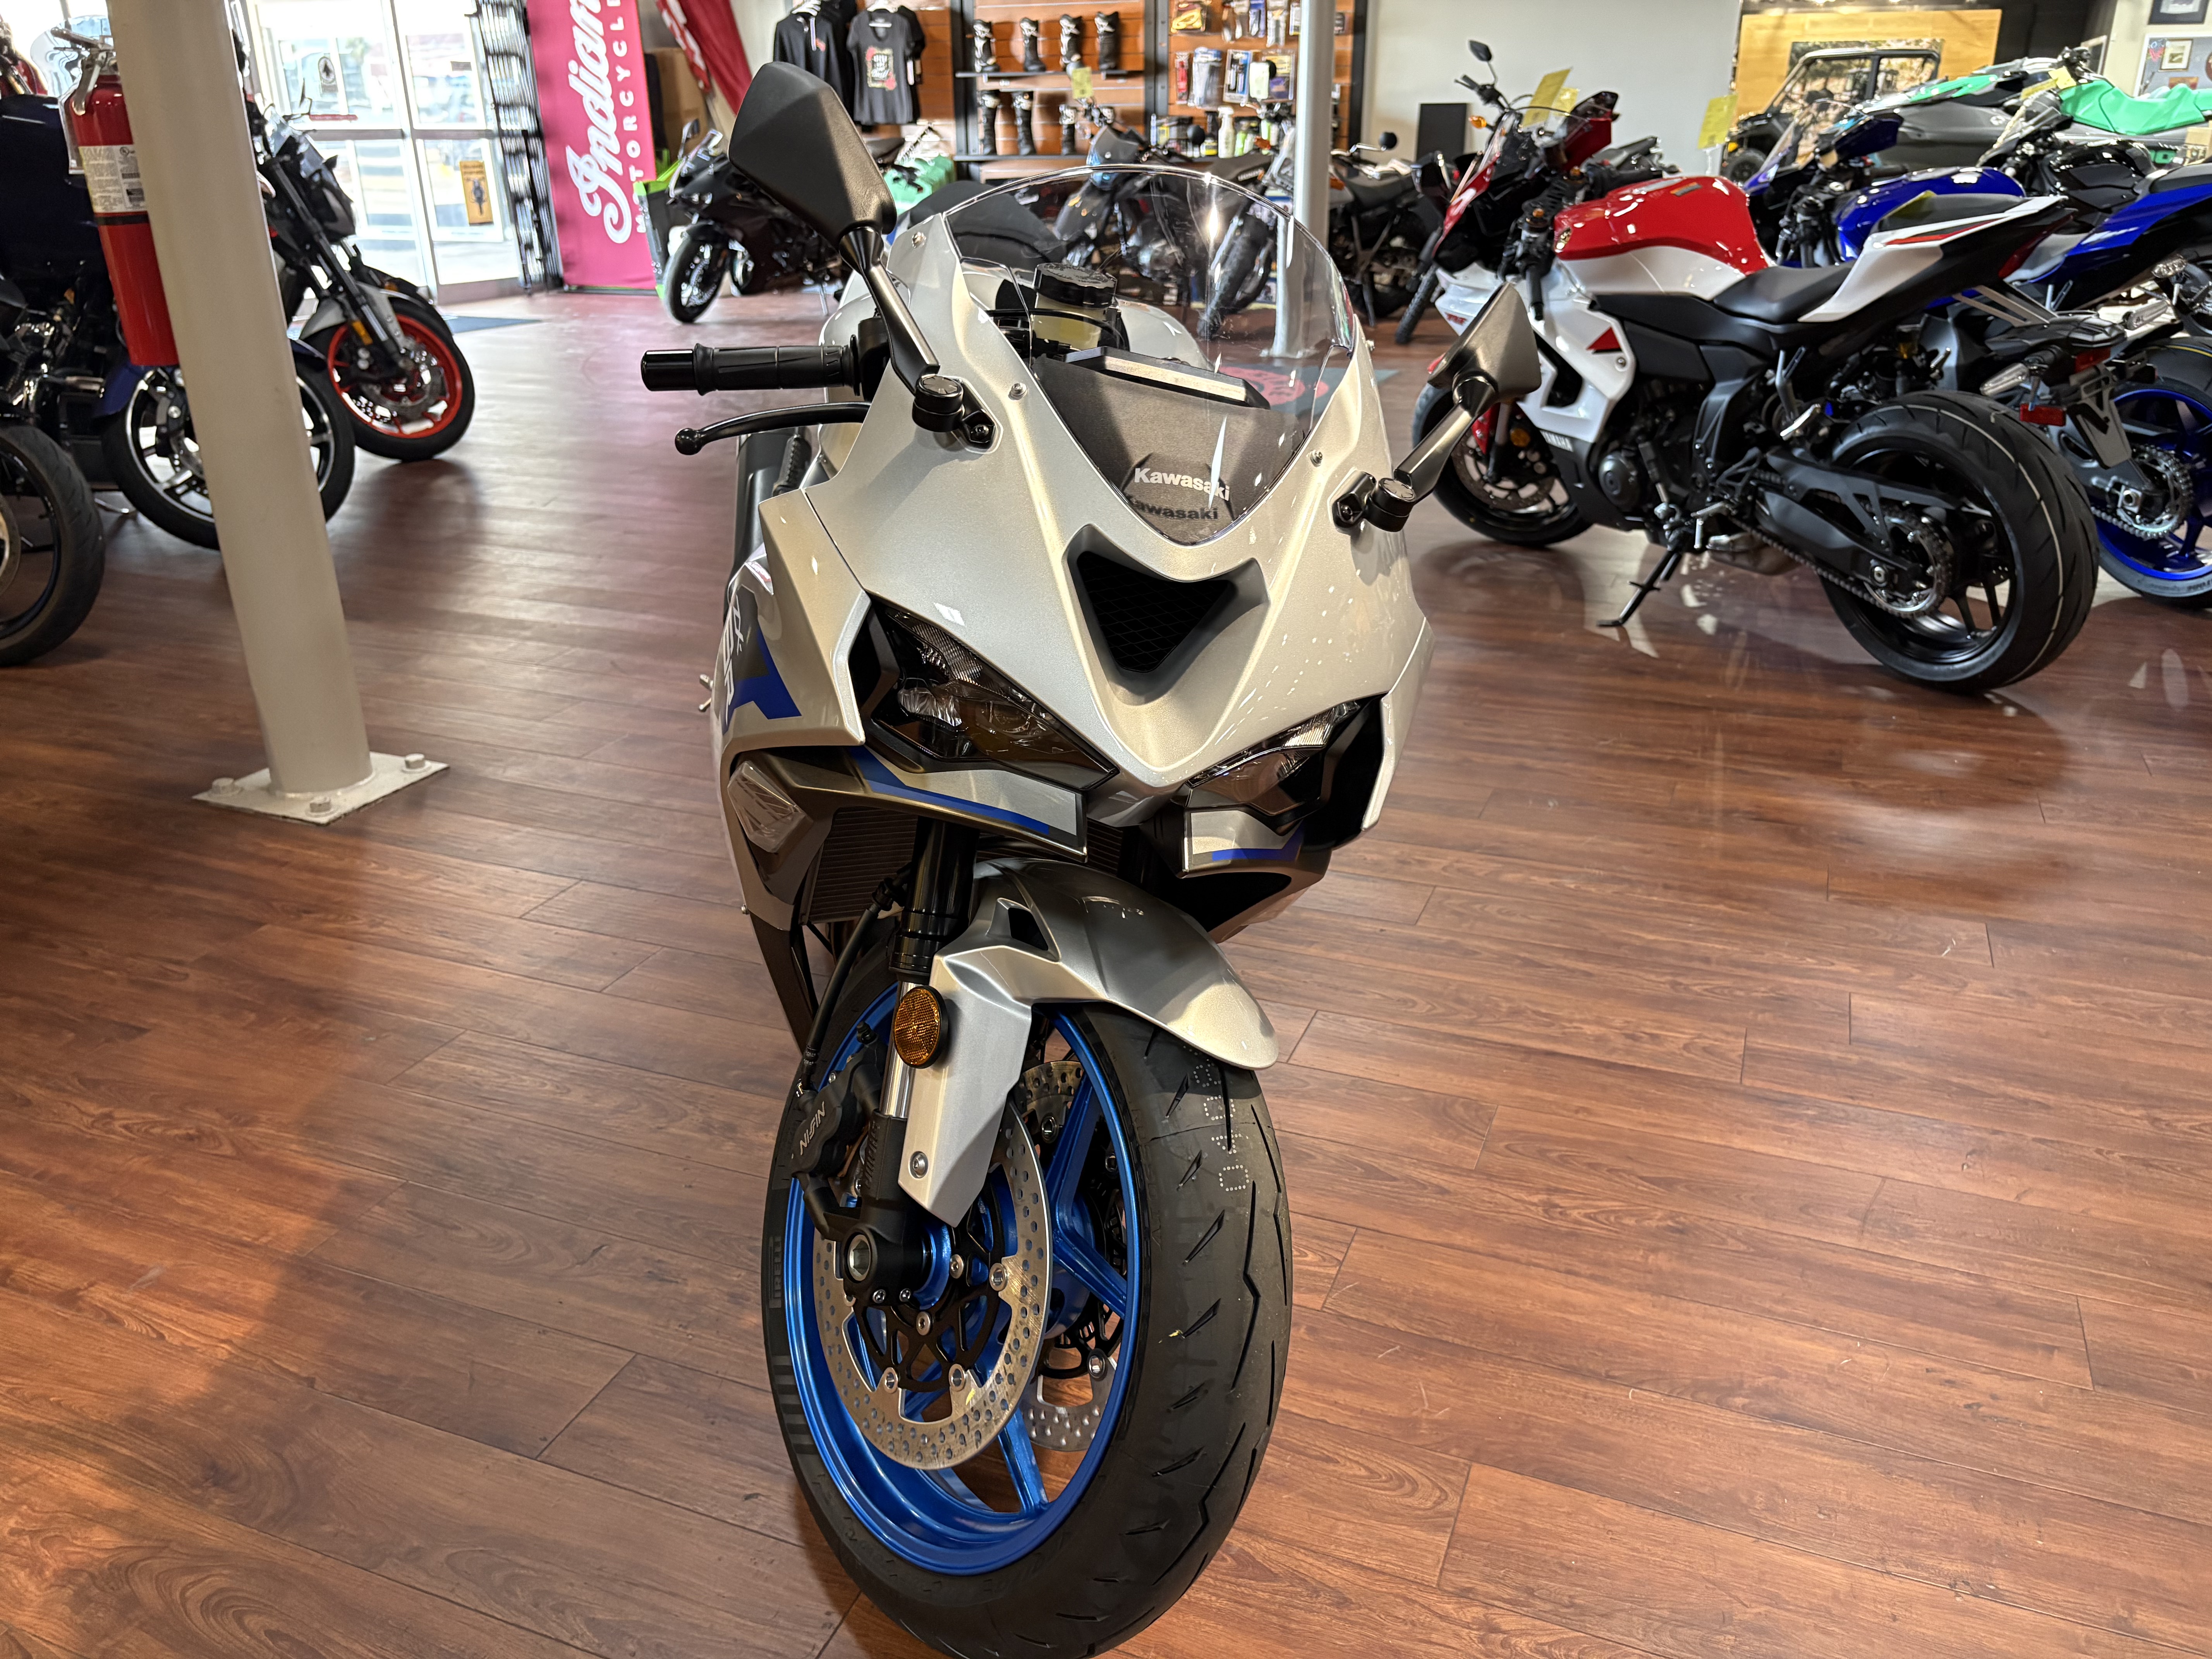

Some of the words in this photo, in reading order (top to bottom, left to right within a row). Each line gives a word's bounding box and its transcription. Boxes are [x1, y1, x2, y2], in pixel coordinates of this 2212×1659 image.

[566, 0, 632, 243] Indian
[1134, 468, 1230, 501] Kawasaki
[1131, 500, 1219, 520] awasaki
